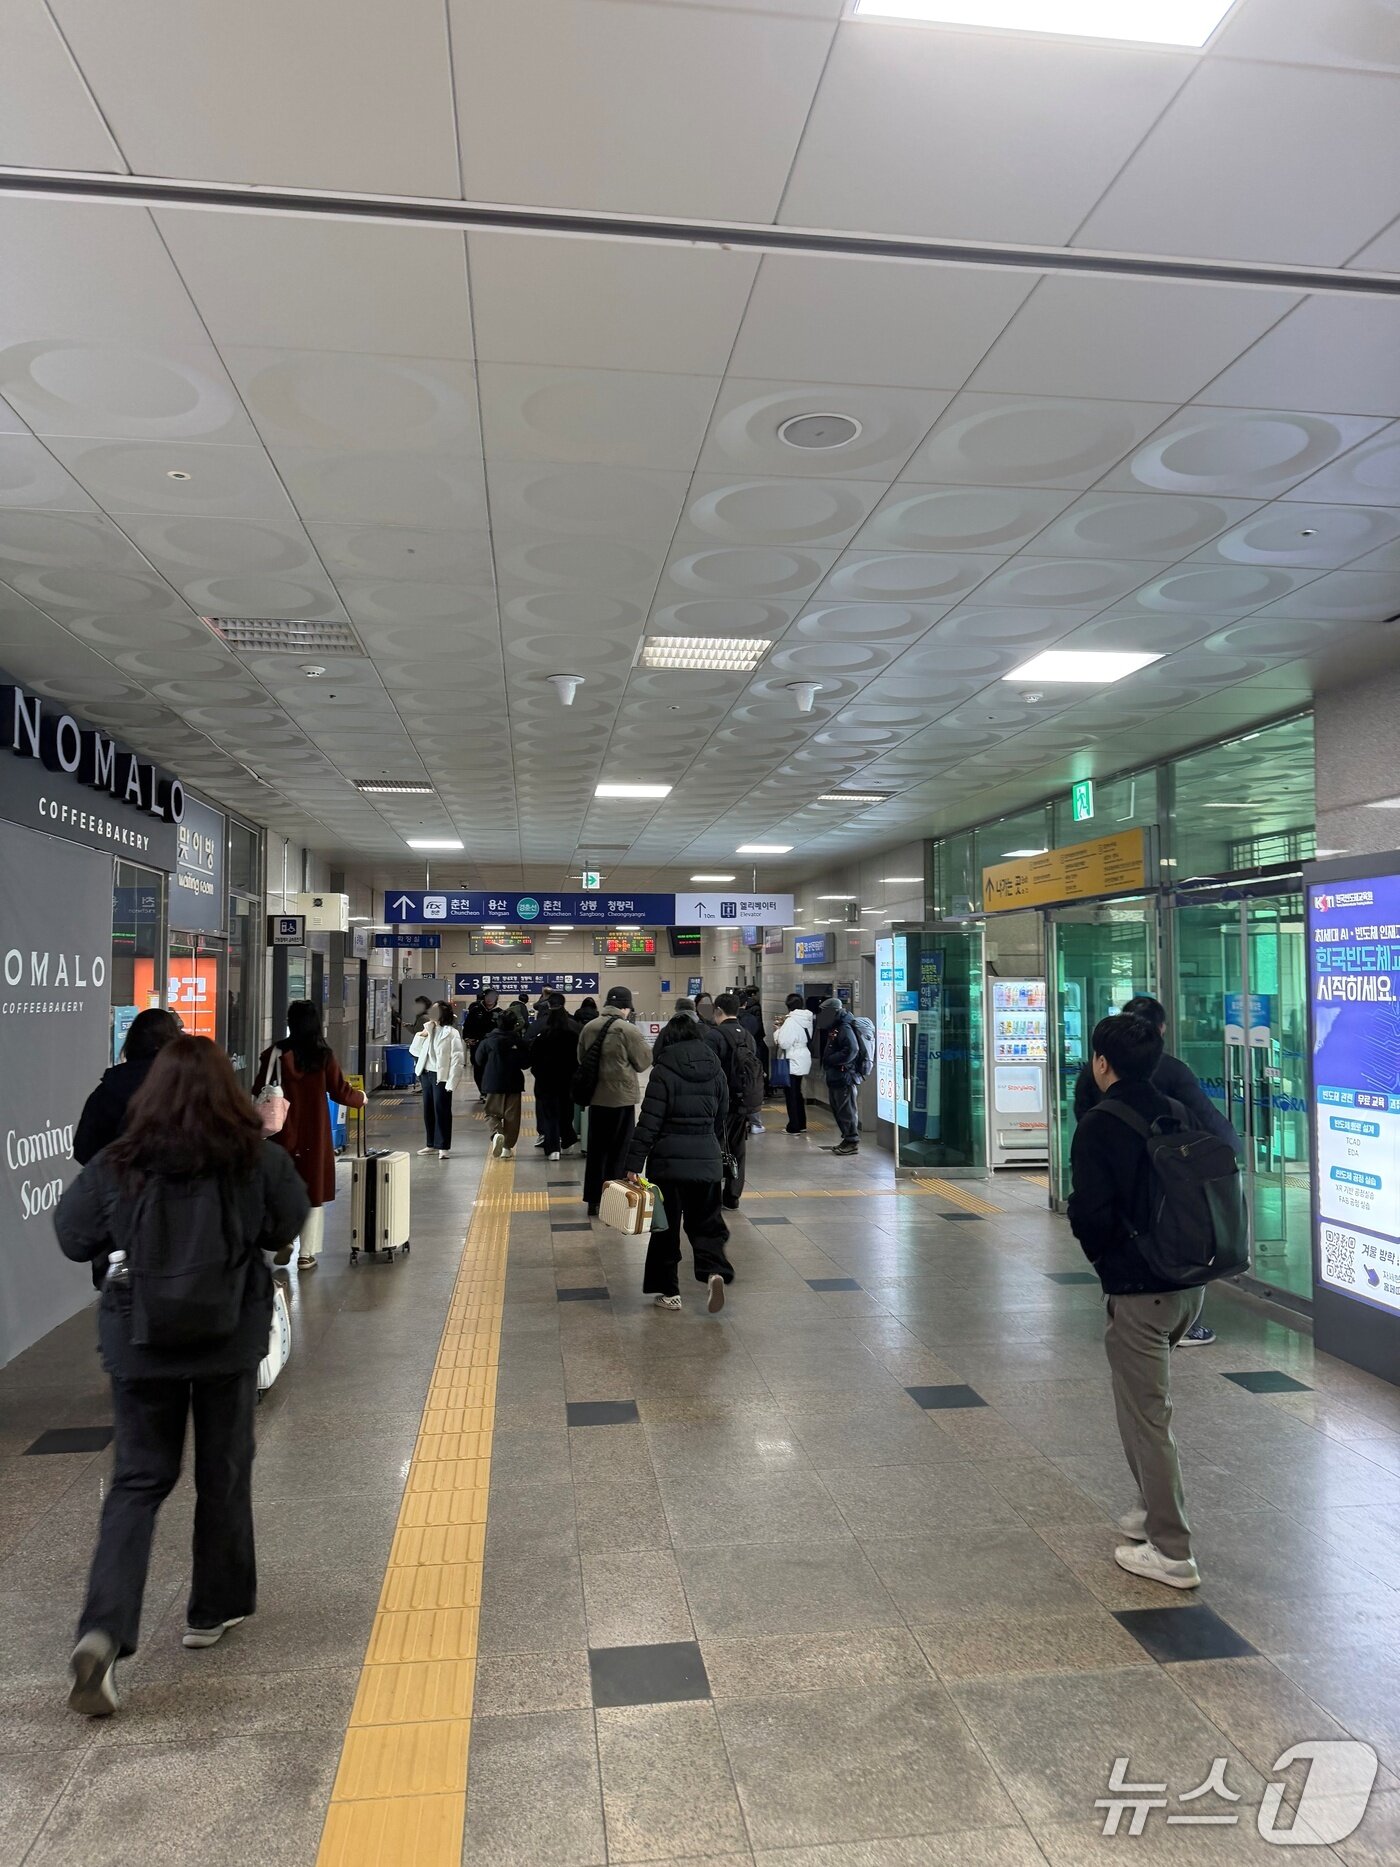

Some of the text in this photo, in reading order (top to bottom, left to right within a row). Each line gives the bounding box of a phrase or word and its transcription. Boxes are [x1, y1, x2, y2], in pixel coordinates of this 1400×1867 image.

[13, 686, 185, 824] NOMALO
[39, 797, 150, 851] COFFEE&BAKERY
[451, 899, 507, 910] 춘천 용산
[543, 901, 634, 911] 춘천 상봉 청량리
[740, 901, 777, 911] 엘리베이터
[473, 979, 480, 989] 3
[575, 979, 583, 989] 2
[1317, 975, 1396, 1001] 시작하세요.
[2, 1002, 83, 1014] COFFEE&BAKERY
[1358, 1094, 1371, 1106] 무료
[1372, 1095, 1385, 1108] 교육
[7, 1120, 74, 1170] Coming
[1346, 1137, 1361, 1146] TCAD
[1348, 1148, 1359, 1157] EDA
[21, 1178, 62, 1220] Soon
[1362, 1244, 1377, 1259] 겨울
[1379, 1249, 1396, 1265] 방학
